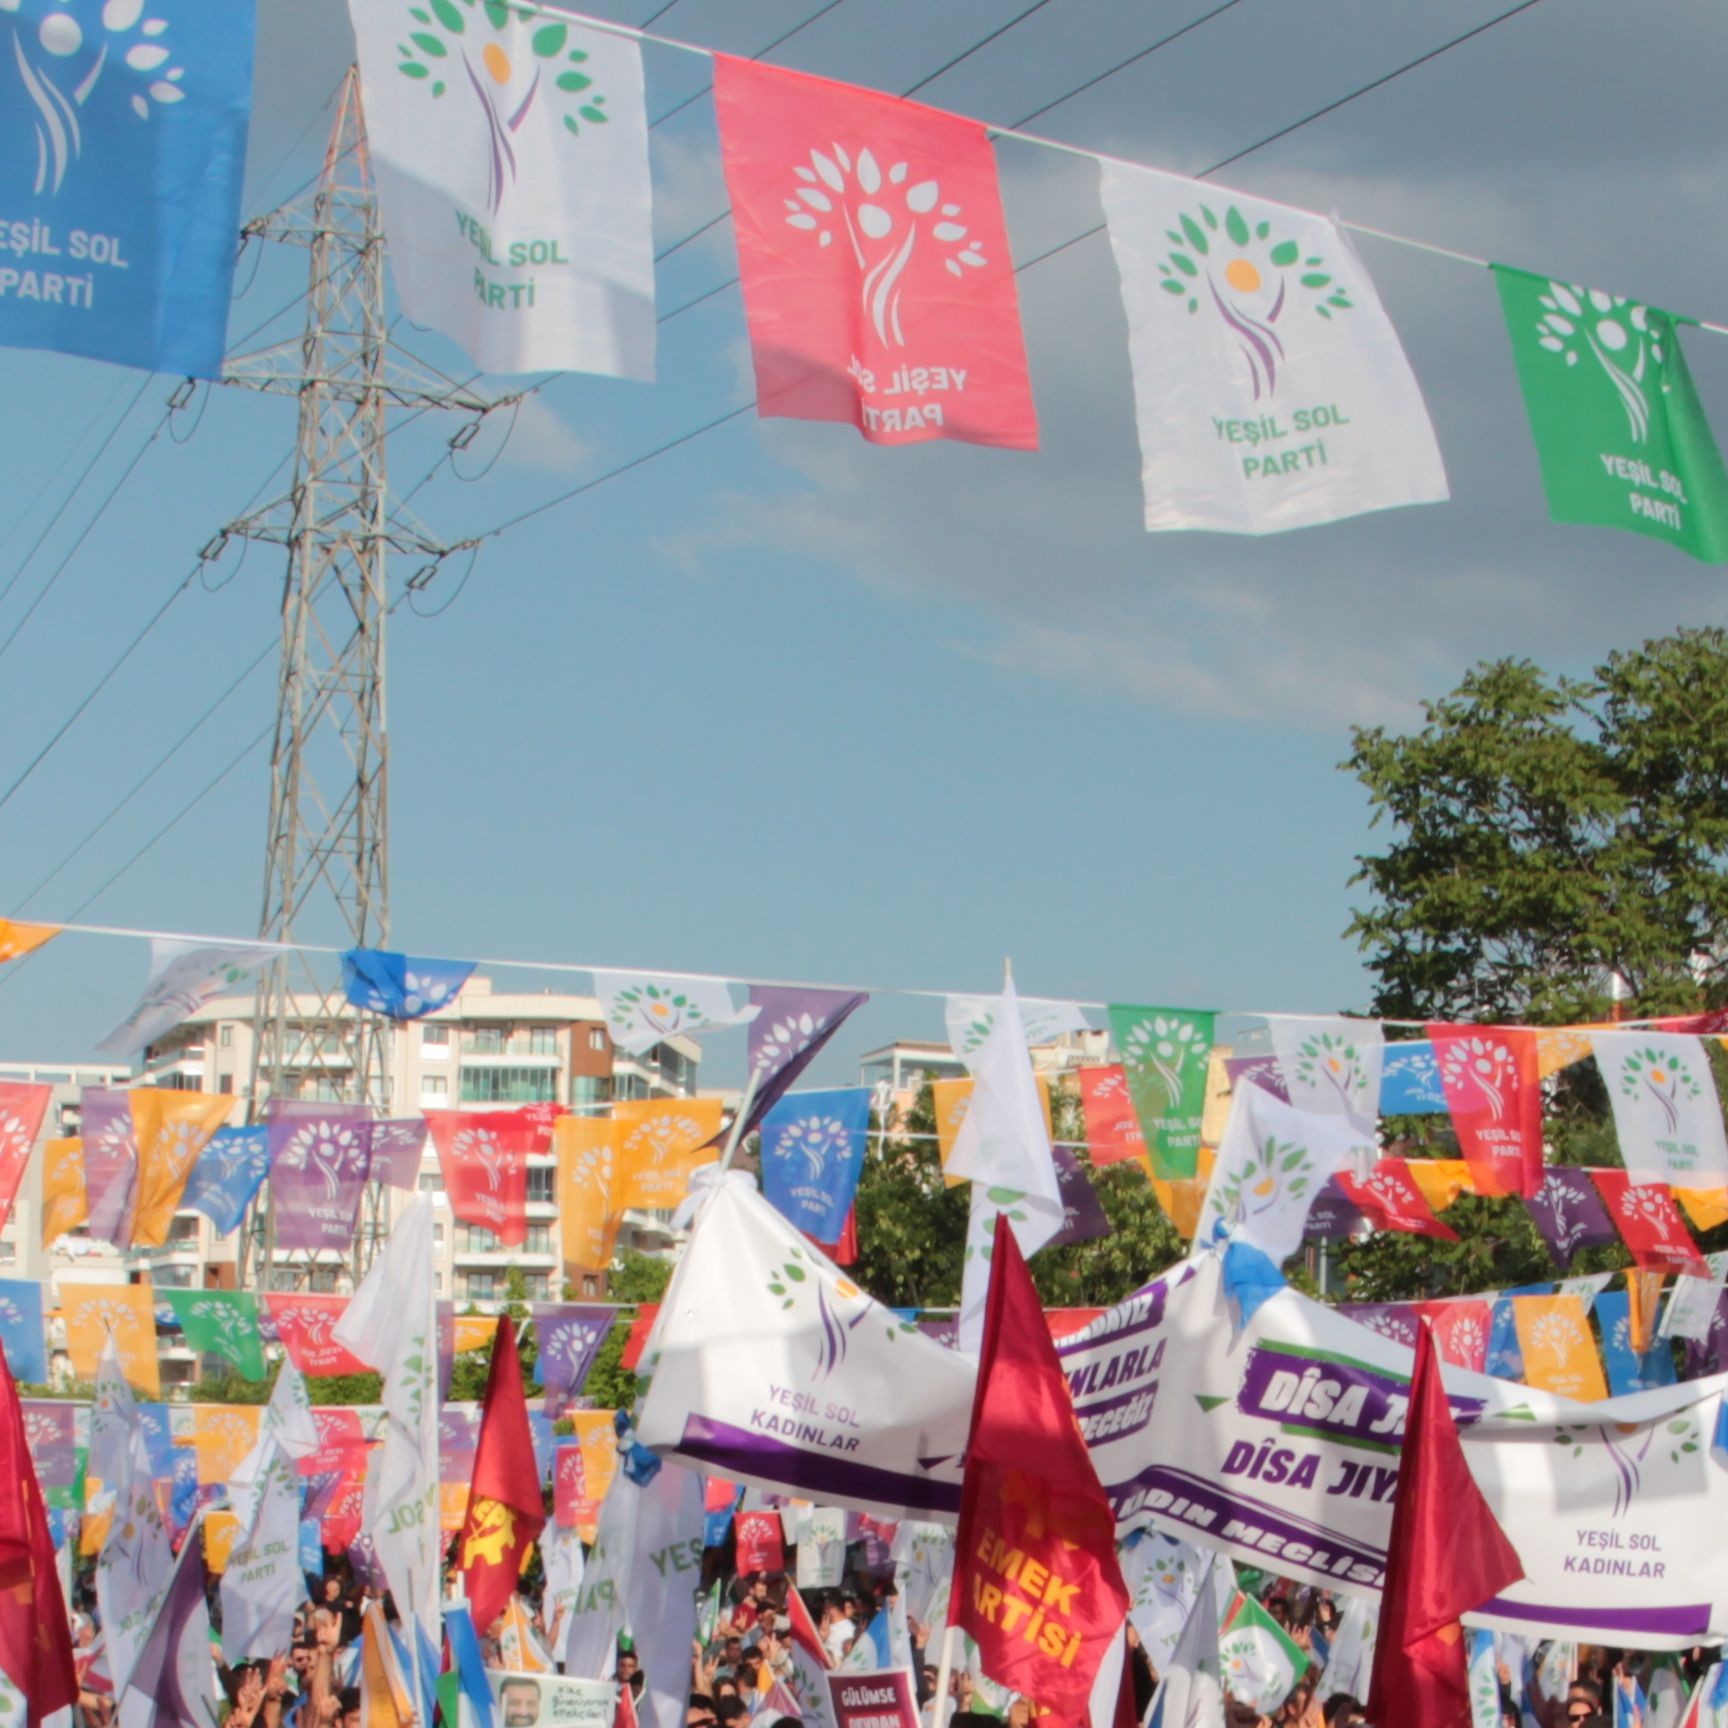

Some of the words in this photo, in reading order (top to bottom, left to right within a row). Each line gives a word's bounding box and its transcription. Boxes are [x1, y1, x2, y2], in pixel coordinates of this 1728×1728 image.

[68, 228, 129, 268] SOL
[509, 239, 569, 269] SOL
[1214, 410, 1289, 448] YEŞİL
[1293, 404, 1350, 434] SOL
[1242, 442, 1328, 480] PARTİ
[1599, 453, 1658, 490] YEŞİL
[1630, 492, 1683, 530] PARTİ
[769, 1384, 822, 1417] YEŞİL
[825, 1403, 862, 1429] SOL
[750, 1408, 862, 1454] KADINLAR
[261, 1541, 286, 1558] SOL
[1575, 1527, 1620, 1558] YEŞİL
[1623, 1532, 1662, 1553] SOL
[241, 1562, 276, 1584] PARTİ
[976, 1527, 1080, 1612] EMEK
[1561, 1554, 1666, 1580] KADINLAR
[841, 1685, 896, 1707] GÜLÜMSE
